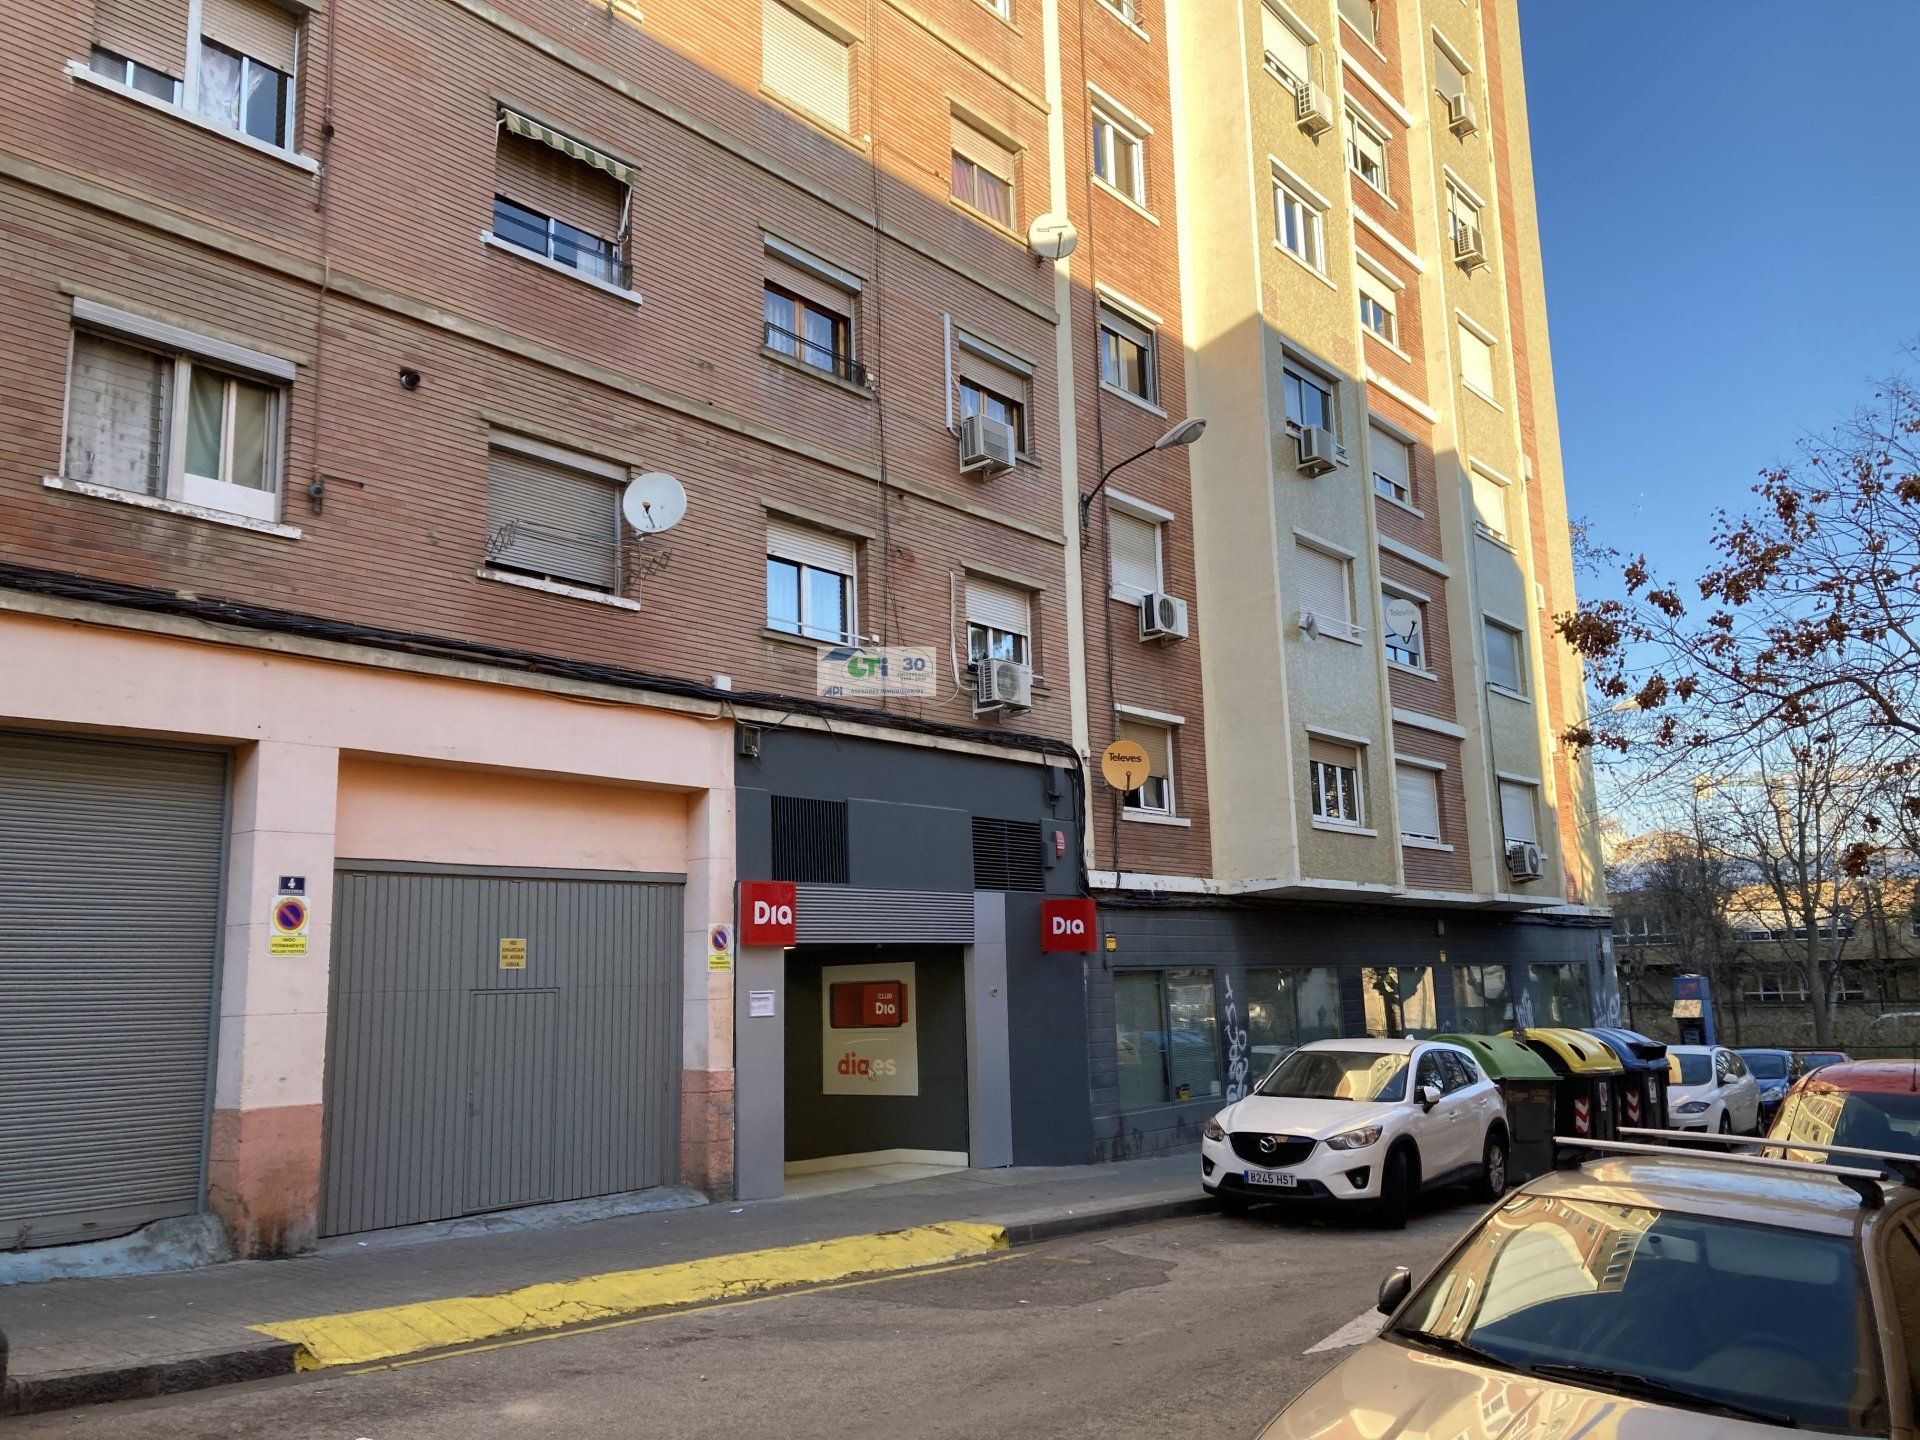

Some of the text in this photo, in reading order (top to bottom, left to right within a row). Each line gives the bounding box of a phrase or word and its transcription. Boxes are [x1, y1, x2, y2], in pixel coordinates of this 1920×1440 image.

[287, 877, 296, 889] 4
[1250, 1172, 1295, 1186] 8245 HST
